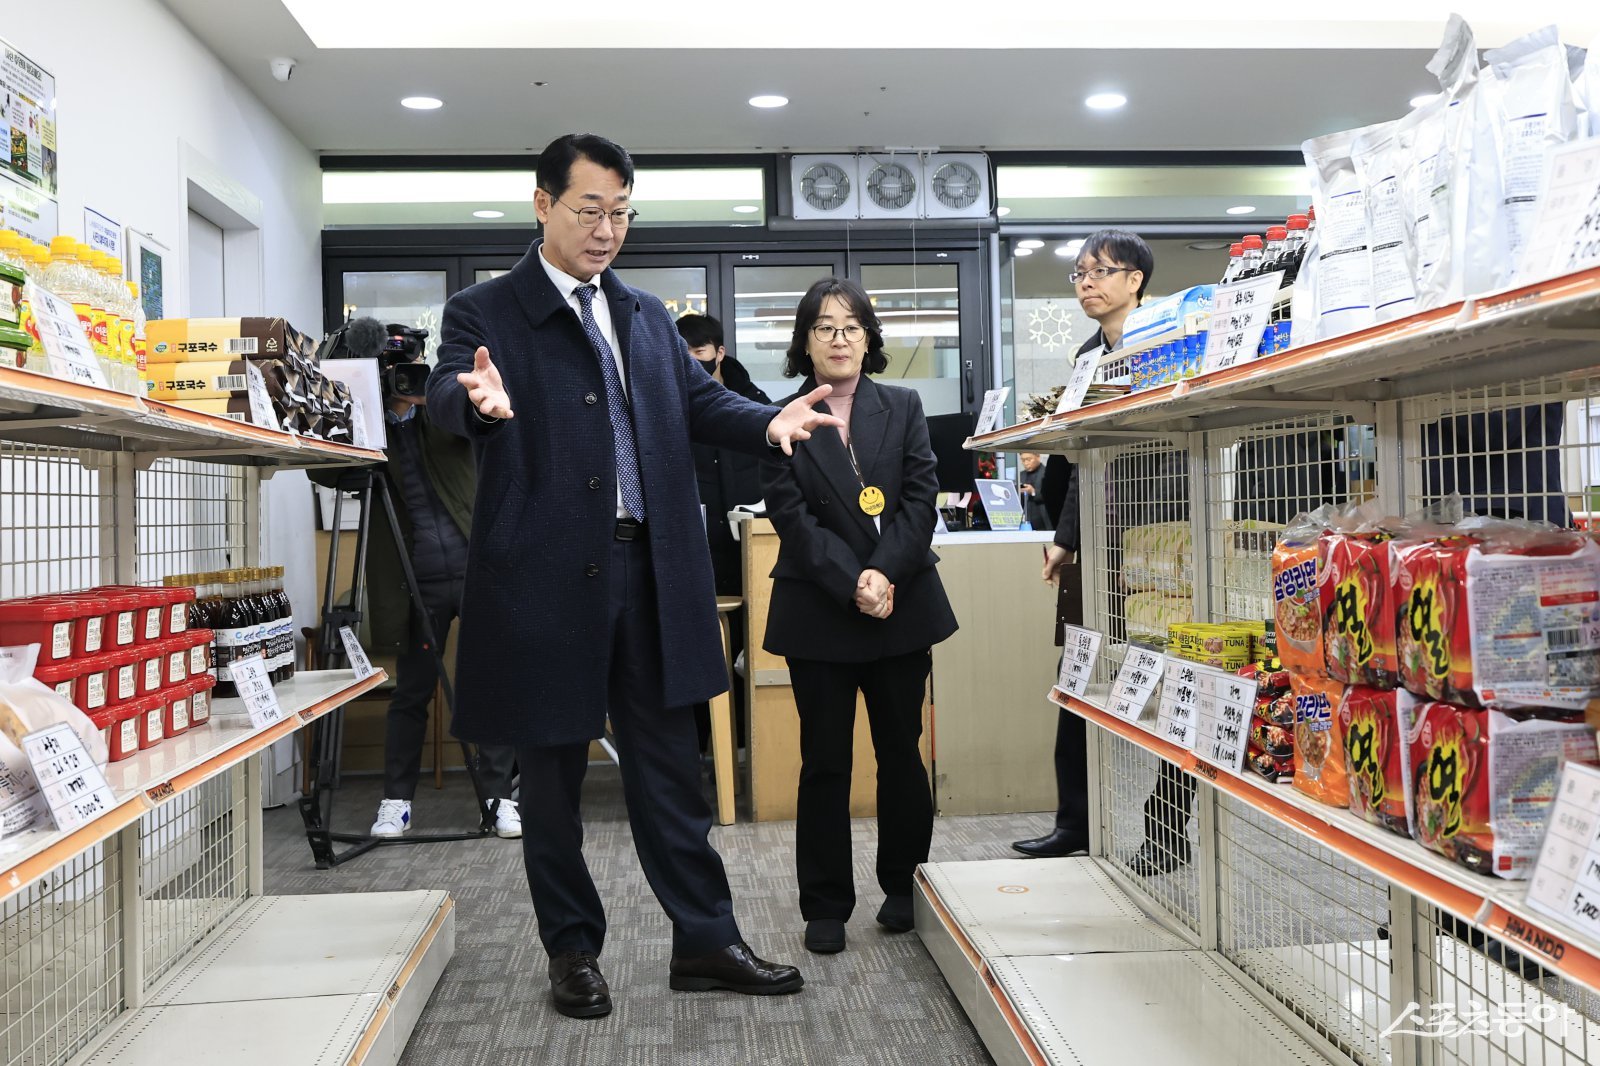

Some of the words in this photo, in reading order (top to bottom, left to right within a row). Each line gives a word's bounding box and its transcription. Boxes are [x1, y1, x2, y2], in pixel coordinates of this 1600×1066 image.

[178, 342, 217, 352] 구포국수
[166, 380, 206, 390] 구포국수
[1274, 558, 1318, 601] 삼양라면
[1225, 639, 1245, 647] TUNA
[1336, 583, 1373, 663] 열
[1410, 587, 1449, 676] 열
[1226, 662, 1245, 670] TUNA
[1350, 723, 1383, 804] 열
[1429, 745, 1461, 836] 열
